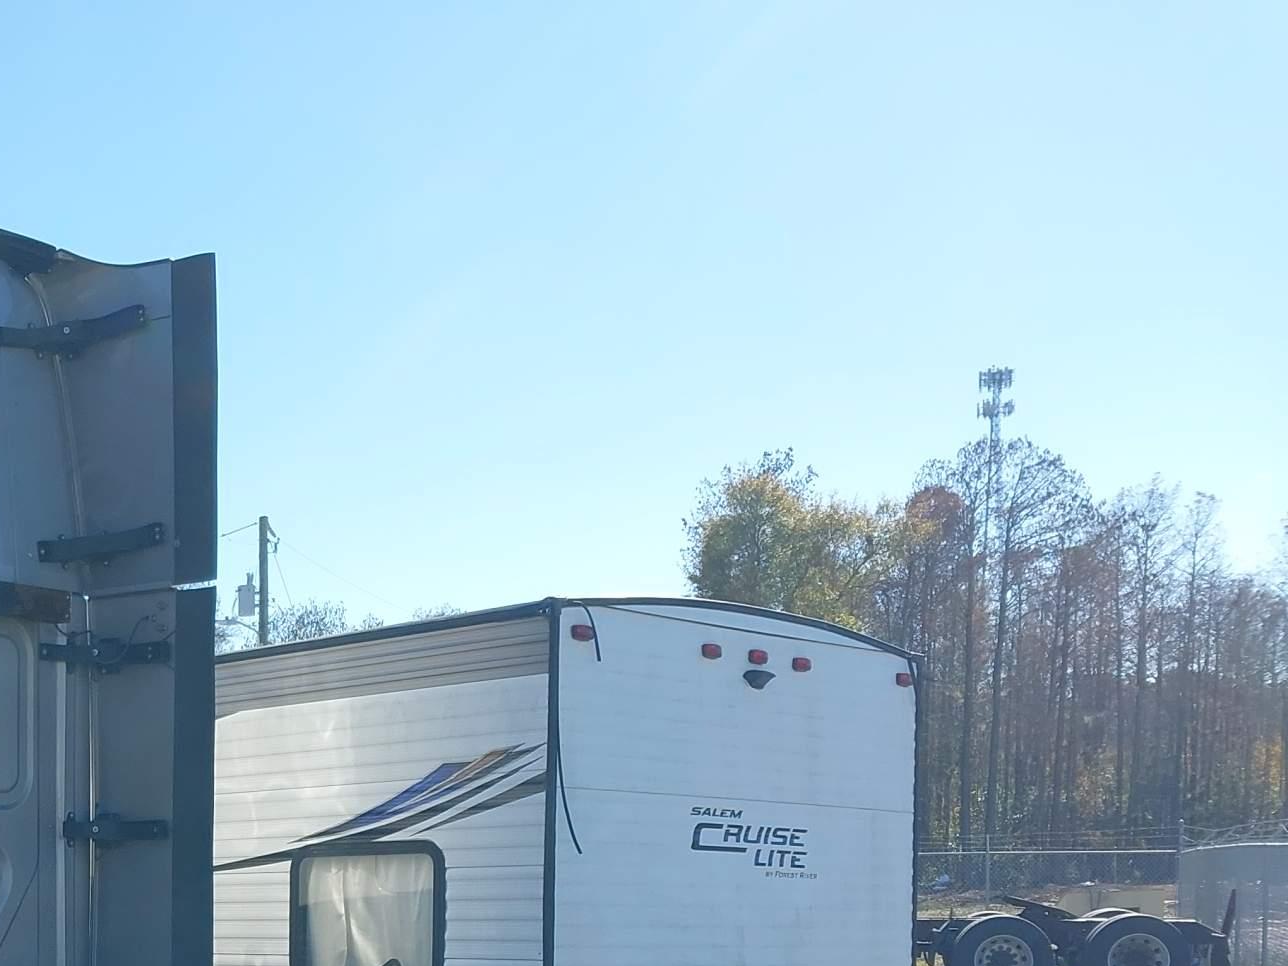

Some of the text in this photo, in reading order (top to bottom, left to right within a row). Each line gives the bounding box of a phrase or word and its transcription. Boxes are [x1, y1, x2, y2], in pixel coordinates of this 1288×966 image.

[690, 806, 743, 819] SALEM
[690, 822, 808, 853] CRUISE
[753, 849, 808, 869] LITE
